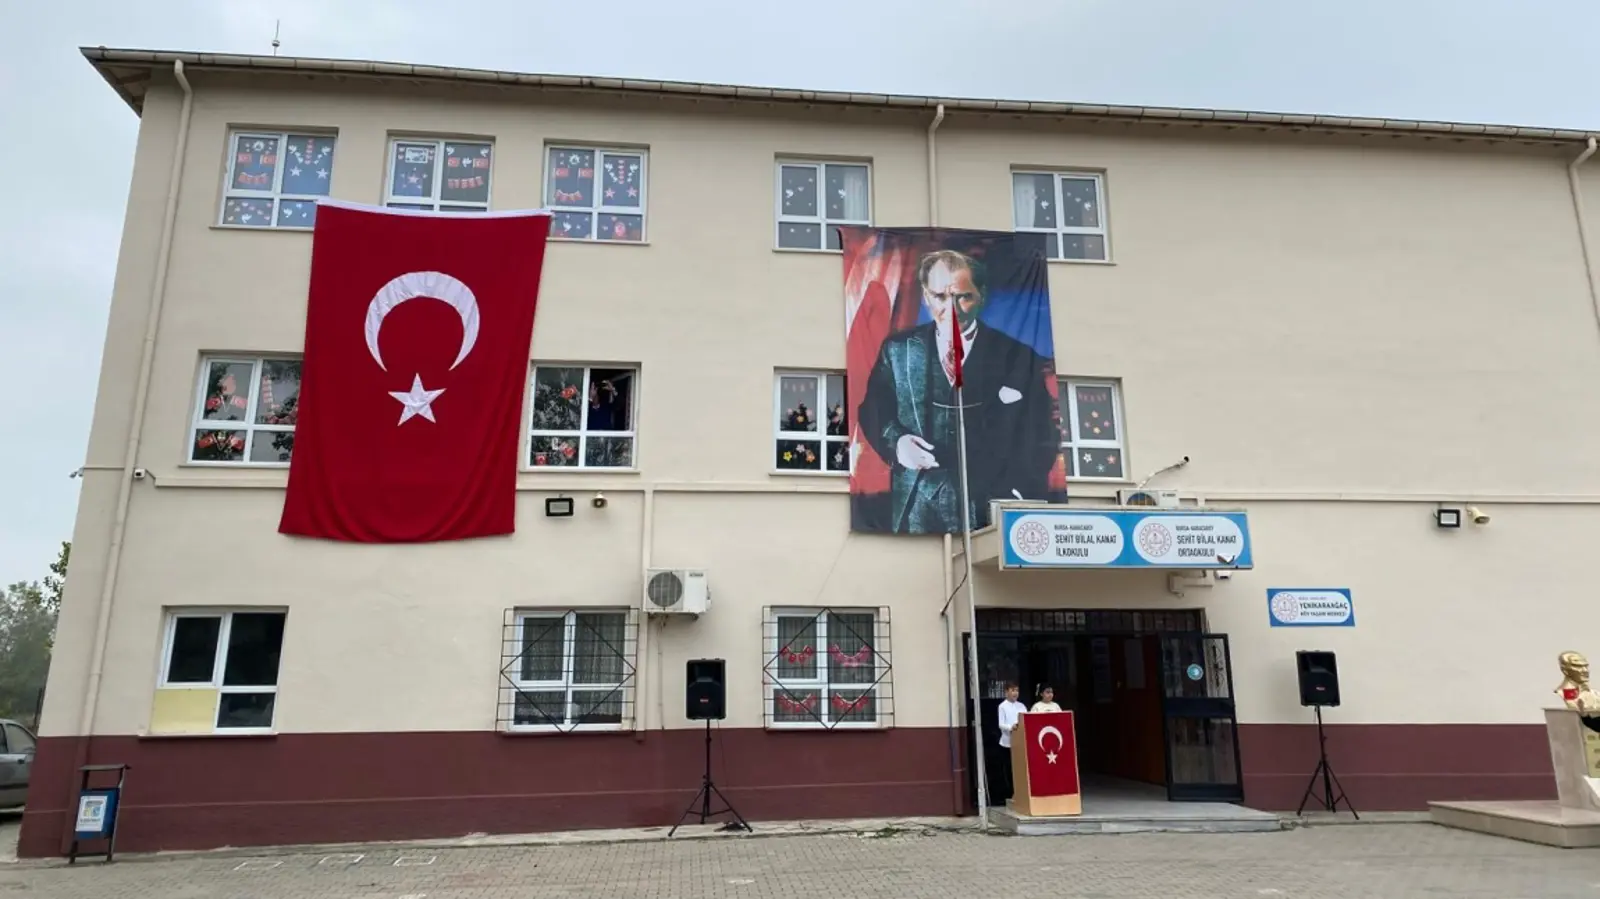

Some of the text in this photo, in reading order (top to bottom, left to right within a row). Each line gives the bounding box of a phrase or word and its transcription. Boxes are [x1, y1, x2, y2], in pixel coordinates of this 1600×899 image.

[1075, 533, 1095, 544] BİLAL
[1096, 534, 1116, 544] KANAT
[1196, 534, 1216, 544] BİLAL
[1217, 535, 1236, 544] KANAT
[1056, 546, 1089, 557] İLKOKULU
[1178, 548, 1215, 557] ORTAOKULU
